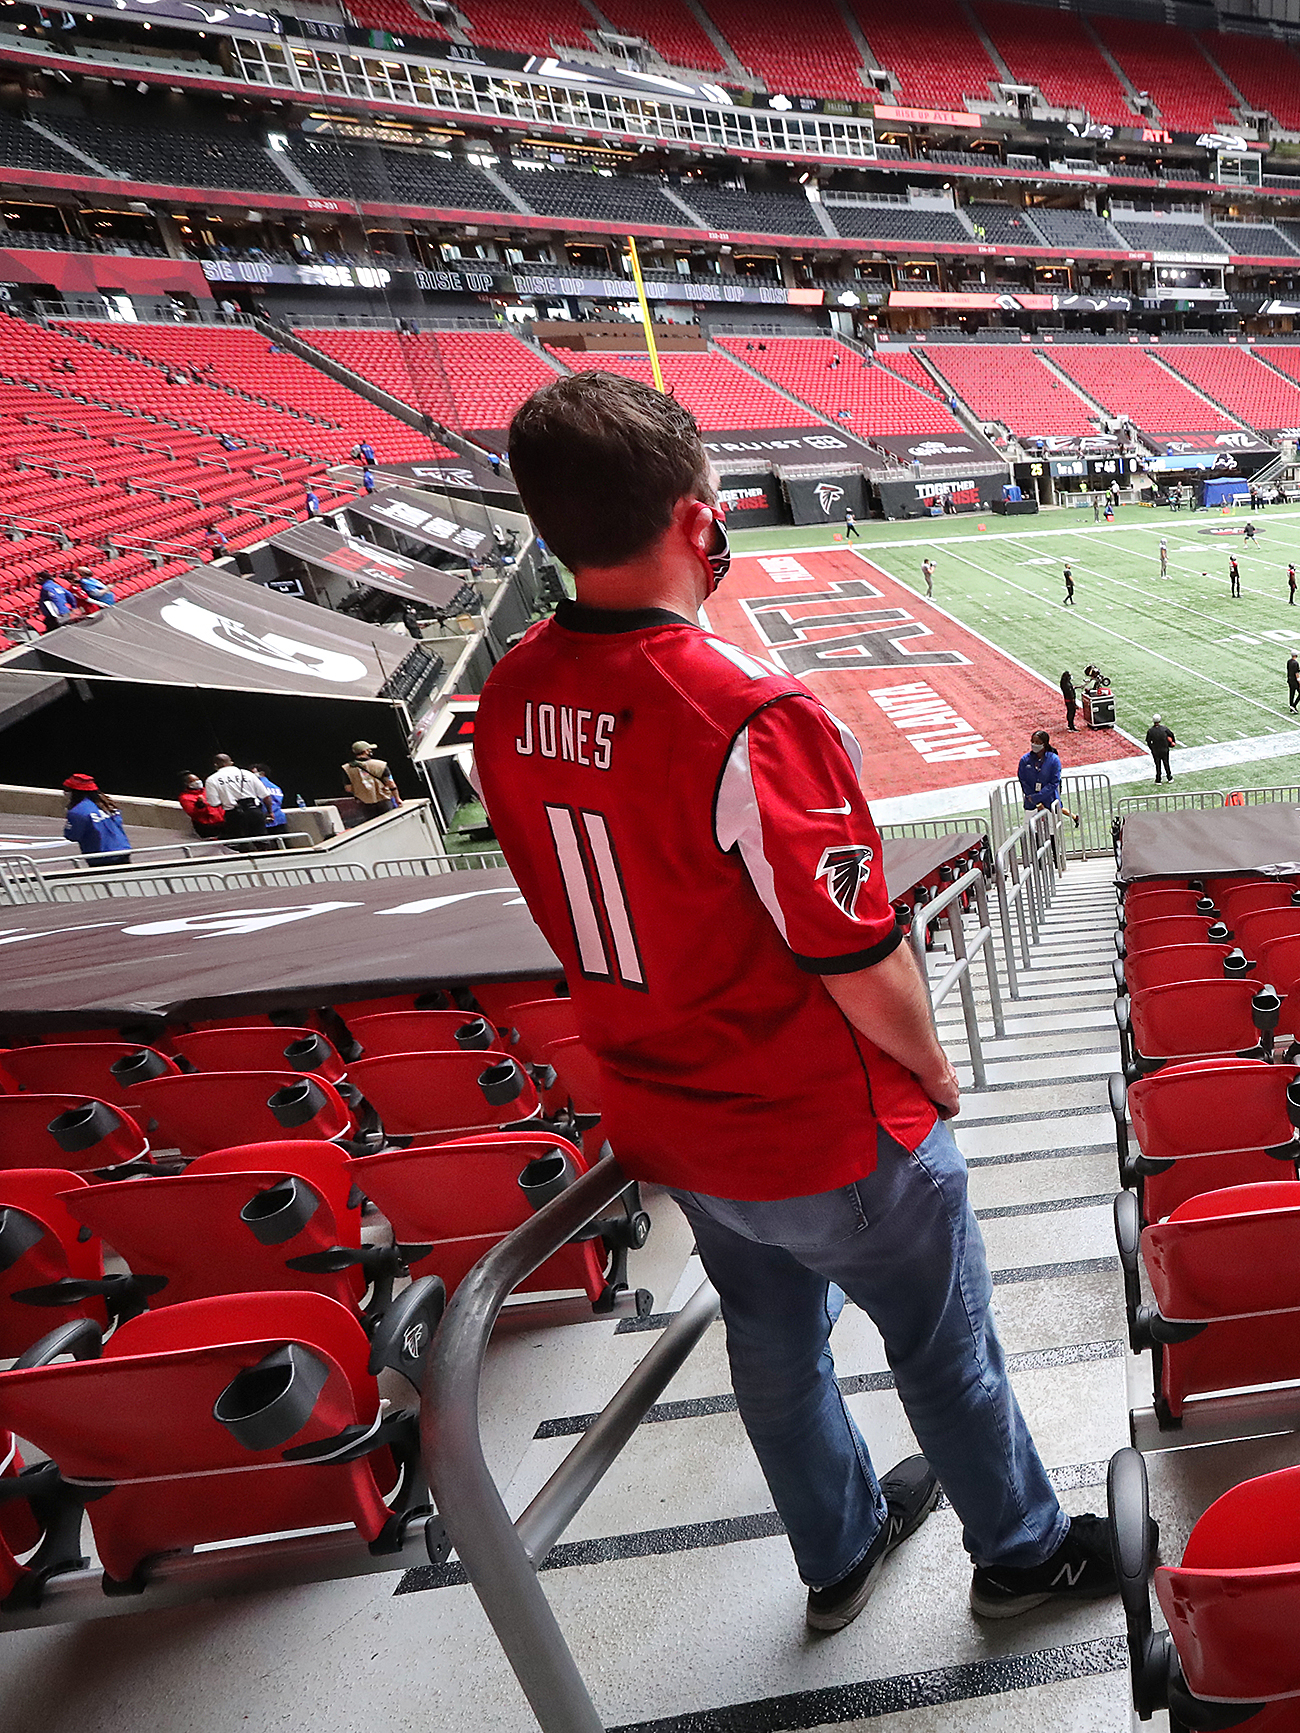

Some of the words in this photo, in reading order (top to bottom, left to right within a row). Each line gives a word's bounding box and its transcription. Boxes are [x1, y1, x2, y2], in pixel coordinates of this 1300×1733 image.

[895, 108, 915, 119] RISE
[917, 112, 930, 120] UP
[933, 112, 958, 122] ATL
[1142, 129, 1173, 144] ATL
[202, 260, 235, 282] SE
[239, 262, 273, 283] UP
[415, 270, 462, 291] RISE
[466, 273, 493, 293] UP
[513, 275, 558, 294] RISE
[560, 278, 585, 295] UP
[646, 282, 669, 298] UP
[684, 283, 722, 301] RISE
[724, 286, 745, 302] UP
[704, 440, 802, 453] TRUIST
[1030, 463, 1043, 476] 25
[717, 488, 763, 501] OGETHER
[914, 480, 976, 501] TOGETHER
[738, 579, 975, 679] ATL
[867, 680, 1001, 764] ATLANTA
[515, 700, 617, 772] JONES
[542, 801, 651, 995] 11
[886, 1516, 904, 1545] N
[1050, 1560, 1088, 1587] N
